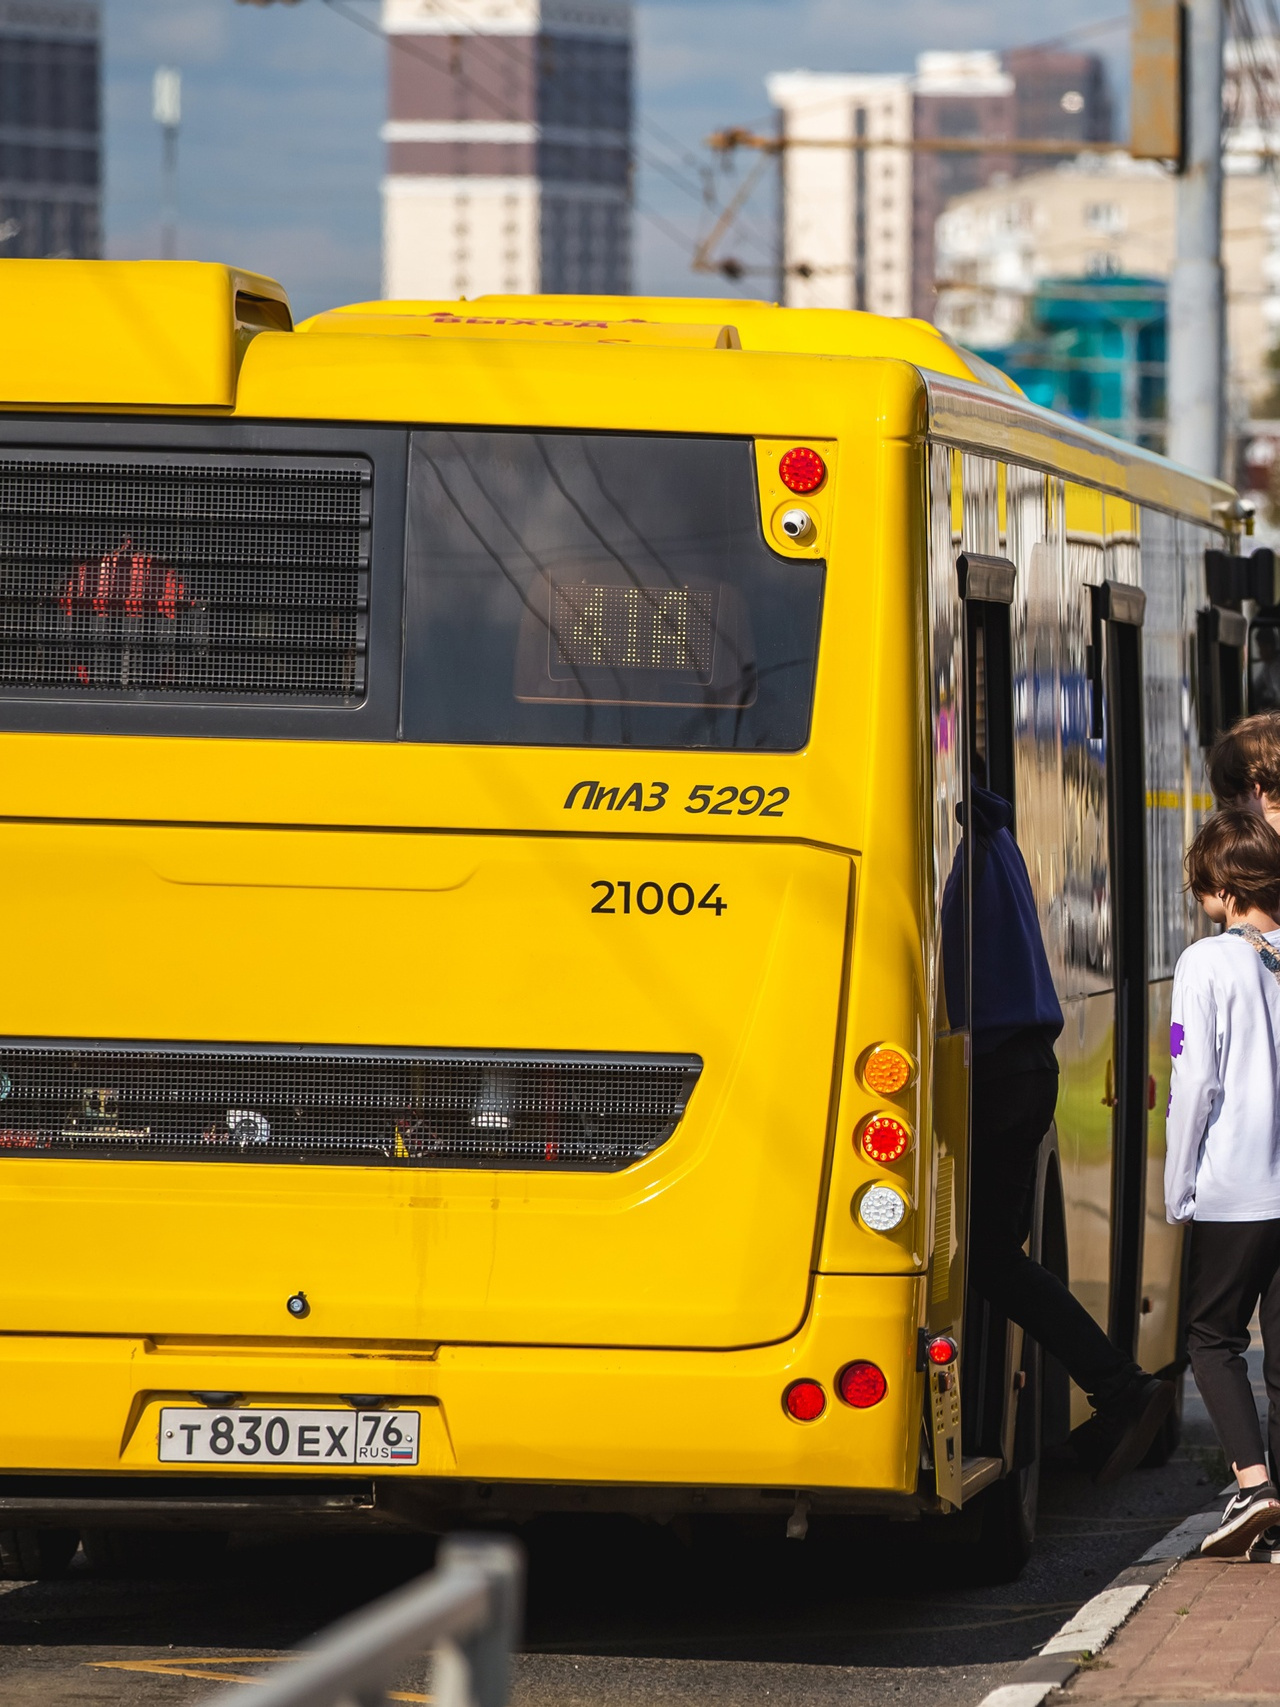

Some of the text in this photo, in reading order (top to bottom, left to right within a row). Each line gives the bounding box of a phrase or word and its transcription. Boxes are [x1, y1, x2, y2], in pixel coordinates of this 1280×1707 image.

[433, 317, 609, 329] ВЫХОД
[684, 784, 790, 817] 5292
[590, 880, 728, 916] 21004
[362, 1415, 403, 1447] 76
[359, 1447, 389, 1459] RUS
